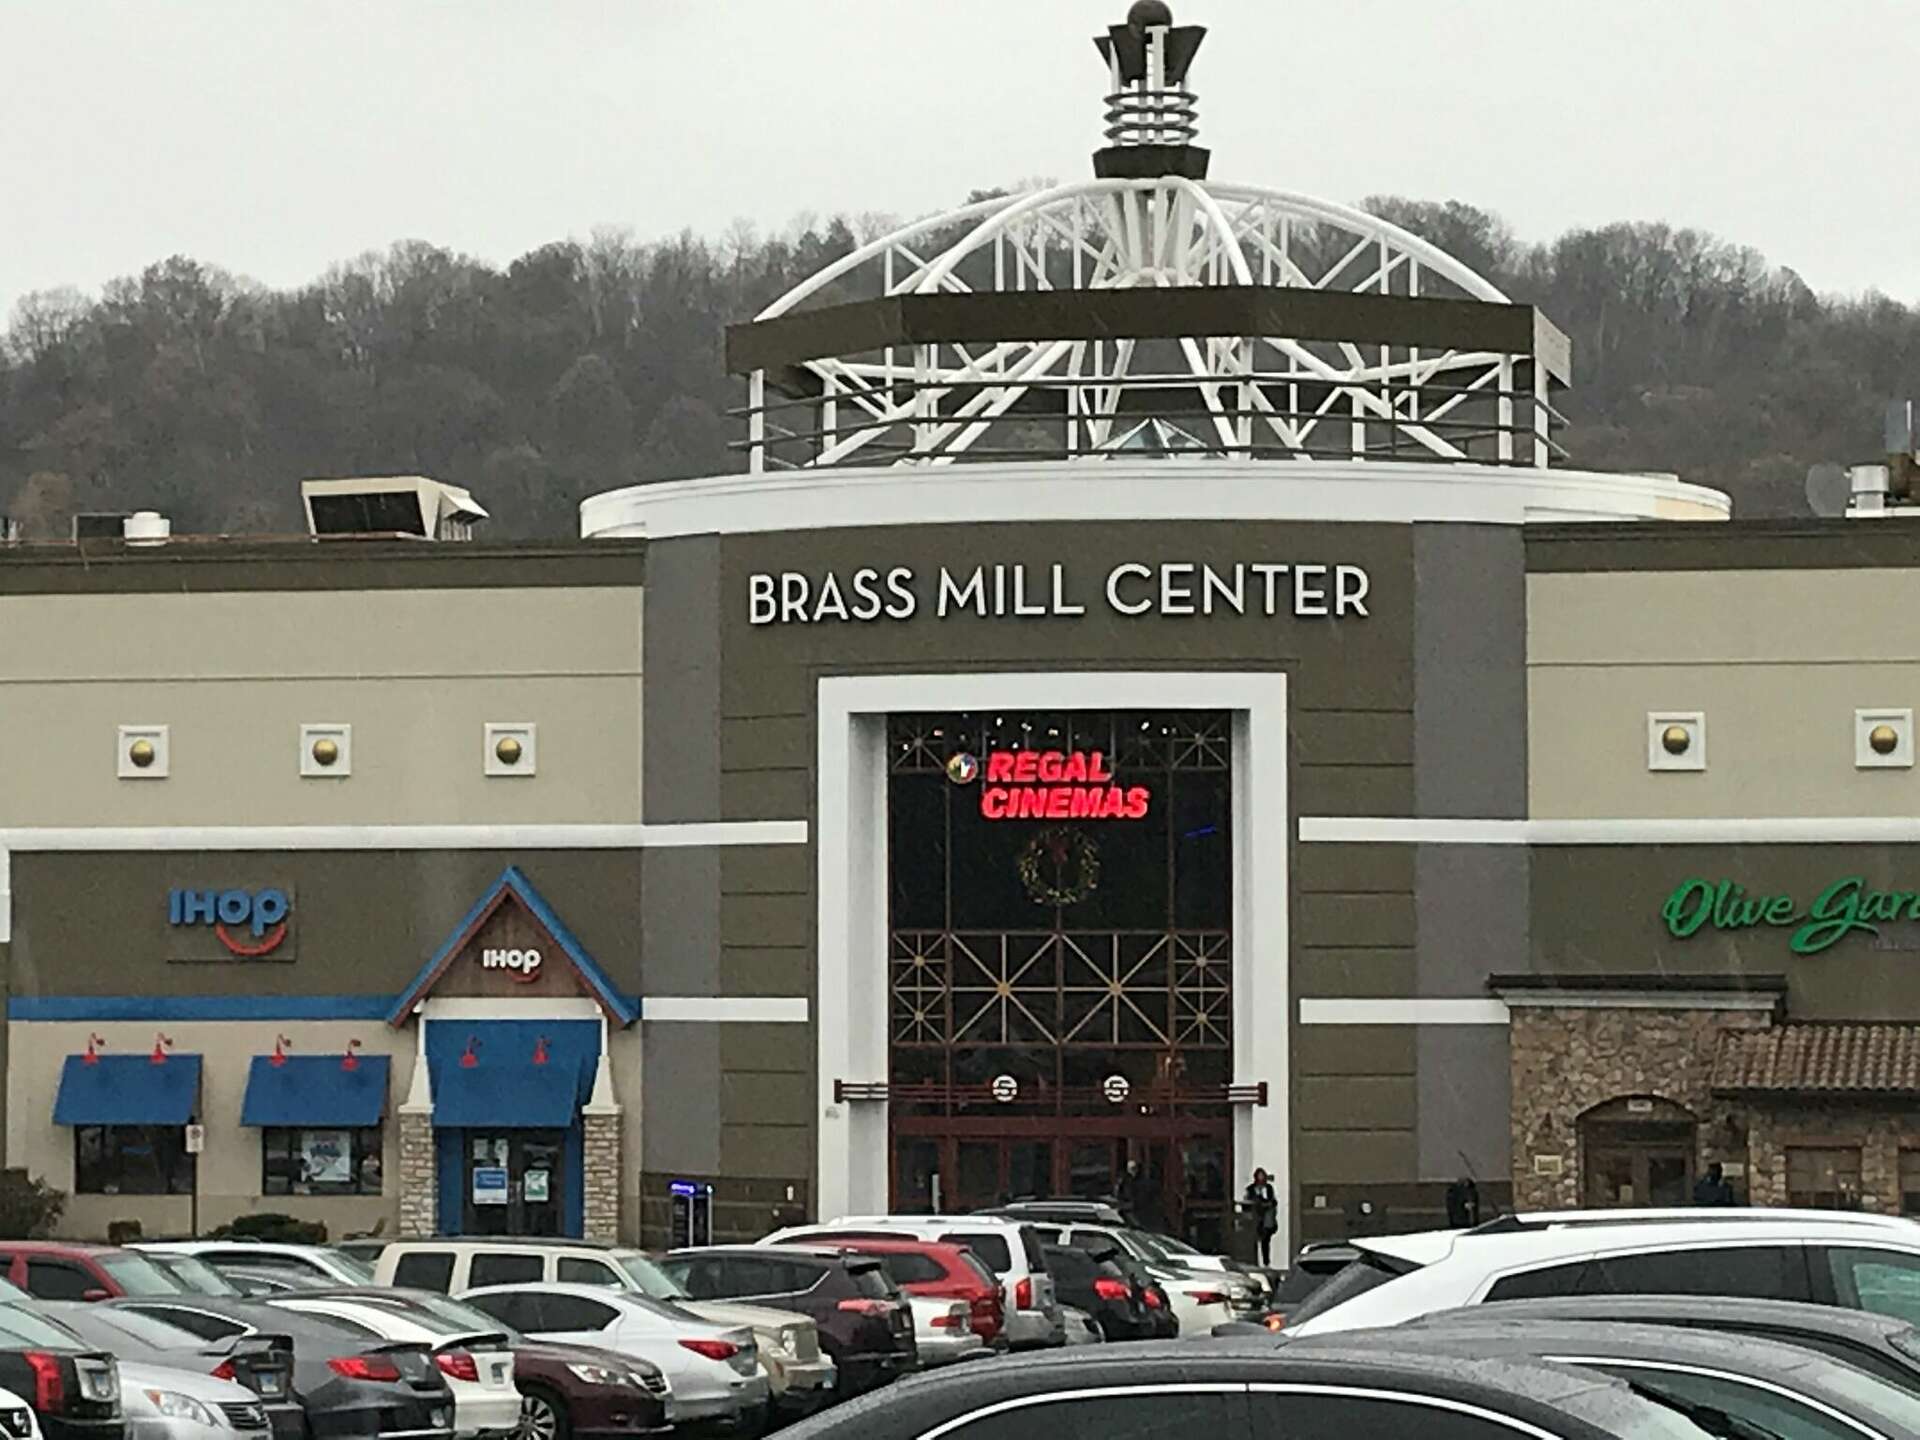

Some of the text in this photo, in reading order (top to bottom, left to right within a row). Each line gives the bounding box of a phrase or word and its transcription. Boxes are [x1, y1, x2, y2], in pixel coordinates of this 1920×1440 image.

[749, 563, 1369, 624] BRASS MILL CENTER
[986, 751, 1113, 783] REGAL
[981, 786, 1150, 819] CINEMAS
[1662, 876, 1807, 938] Olive
